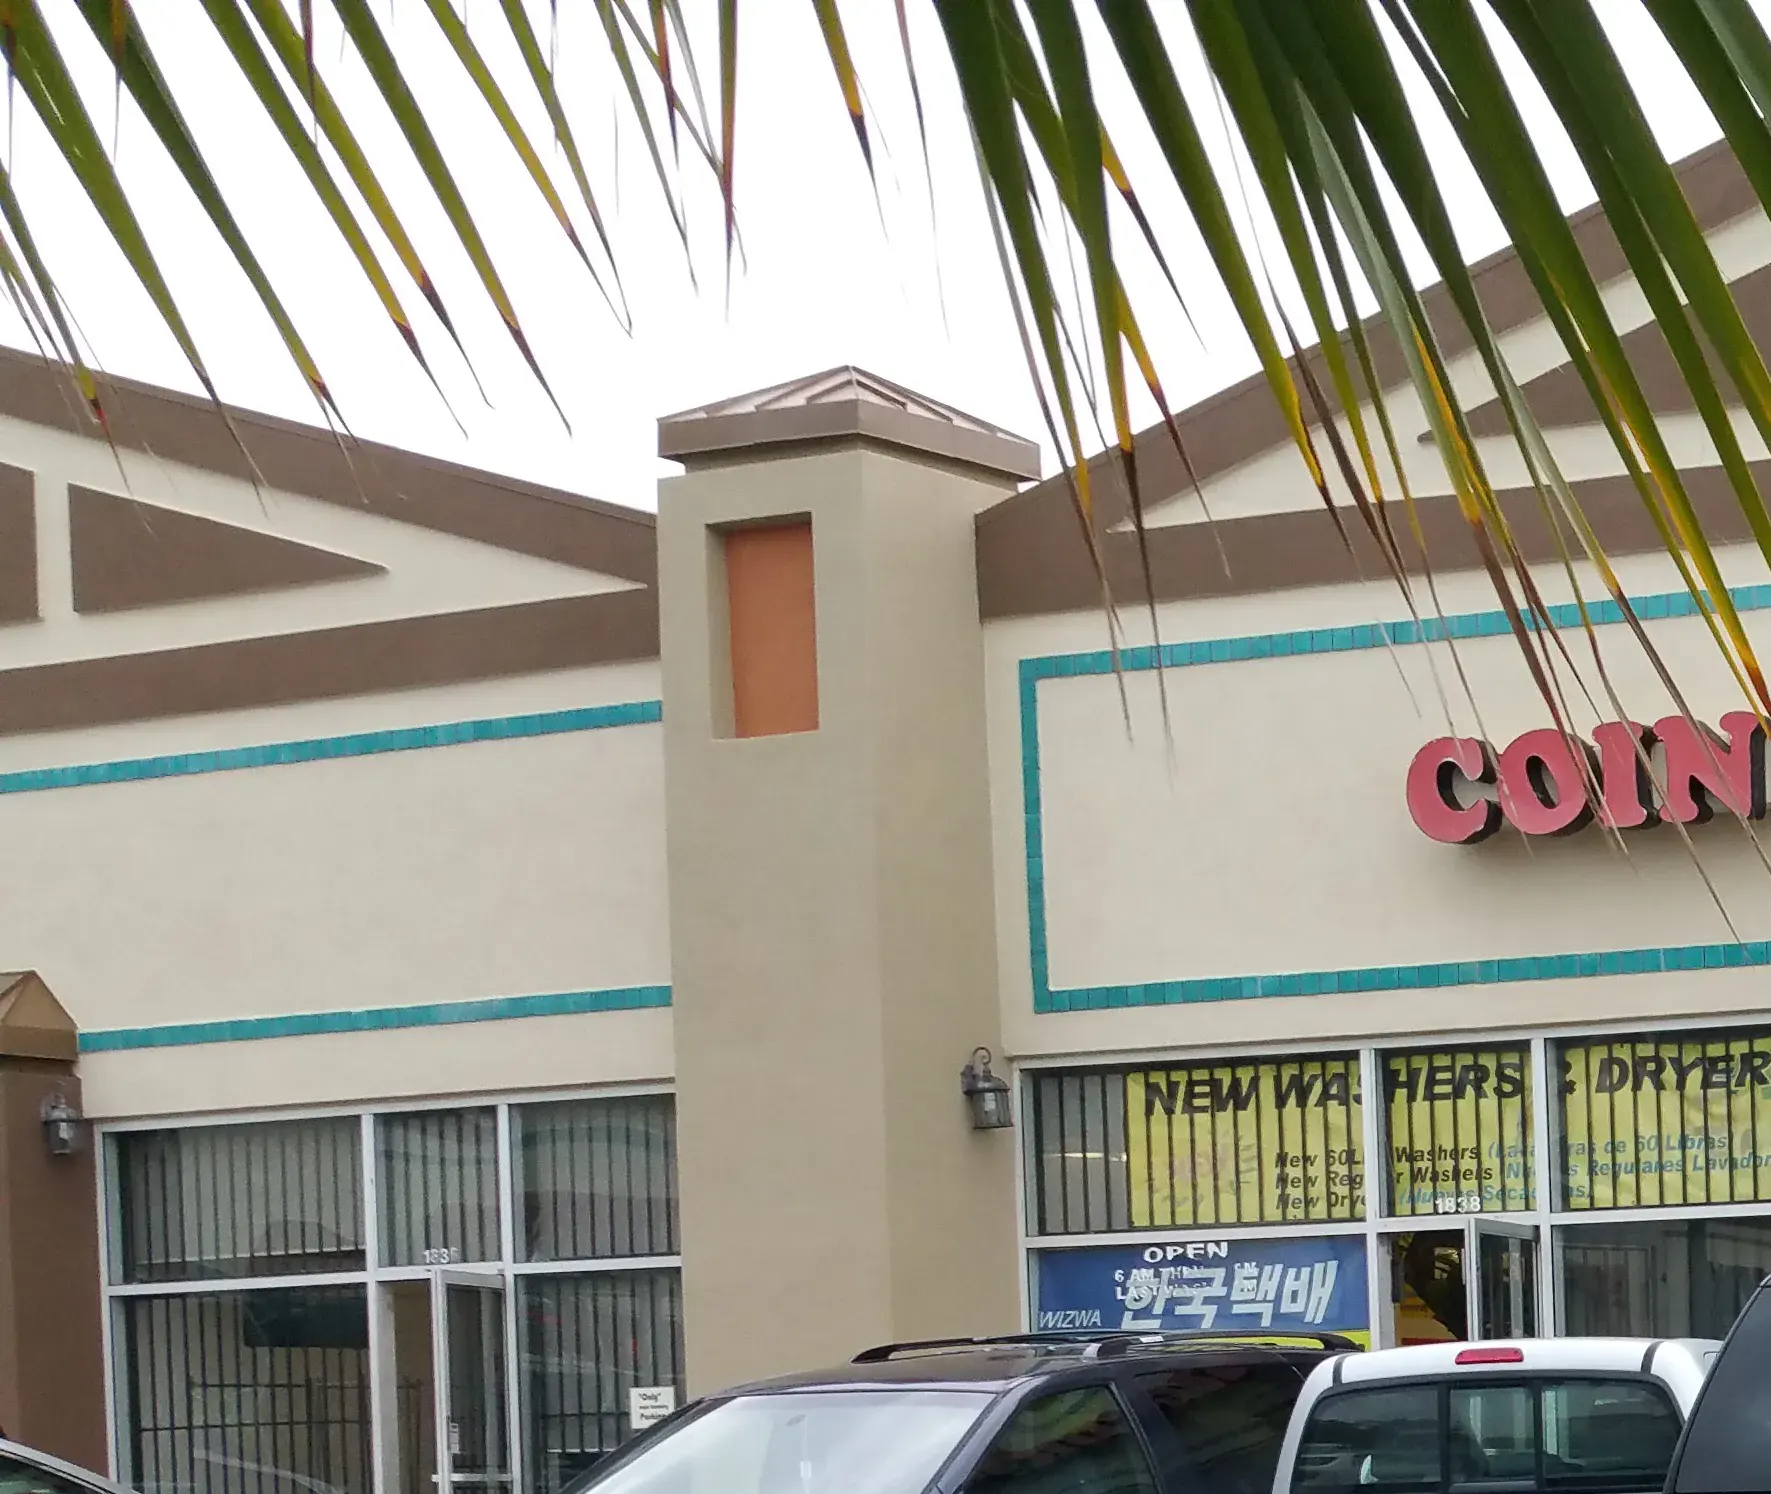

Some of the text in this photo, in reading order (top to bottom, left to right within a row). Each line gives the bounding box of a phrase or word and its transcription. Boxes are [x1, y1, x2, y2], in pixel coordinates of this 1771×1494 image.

[1405, 712, 1771, 845] COIN
[1145, 1075, 1261, 1116] NEW
[1274, 1062, 1524, 1111] WAHERS
[1329, 1170, 1404, 1190] Regr
[1434, 1196, 1481, 1214] 1838
[1143, 1241, 1228, 1264] OPEN
[1114, 1269, 1125, 1282] 6
[1121, 1260, 1339, 1329] 한국택배
[1038, 1309, 1101, 1329] WIZWA
